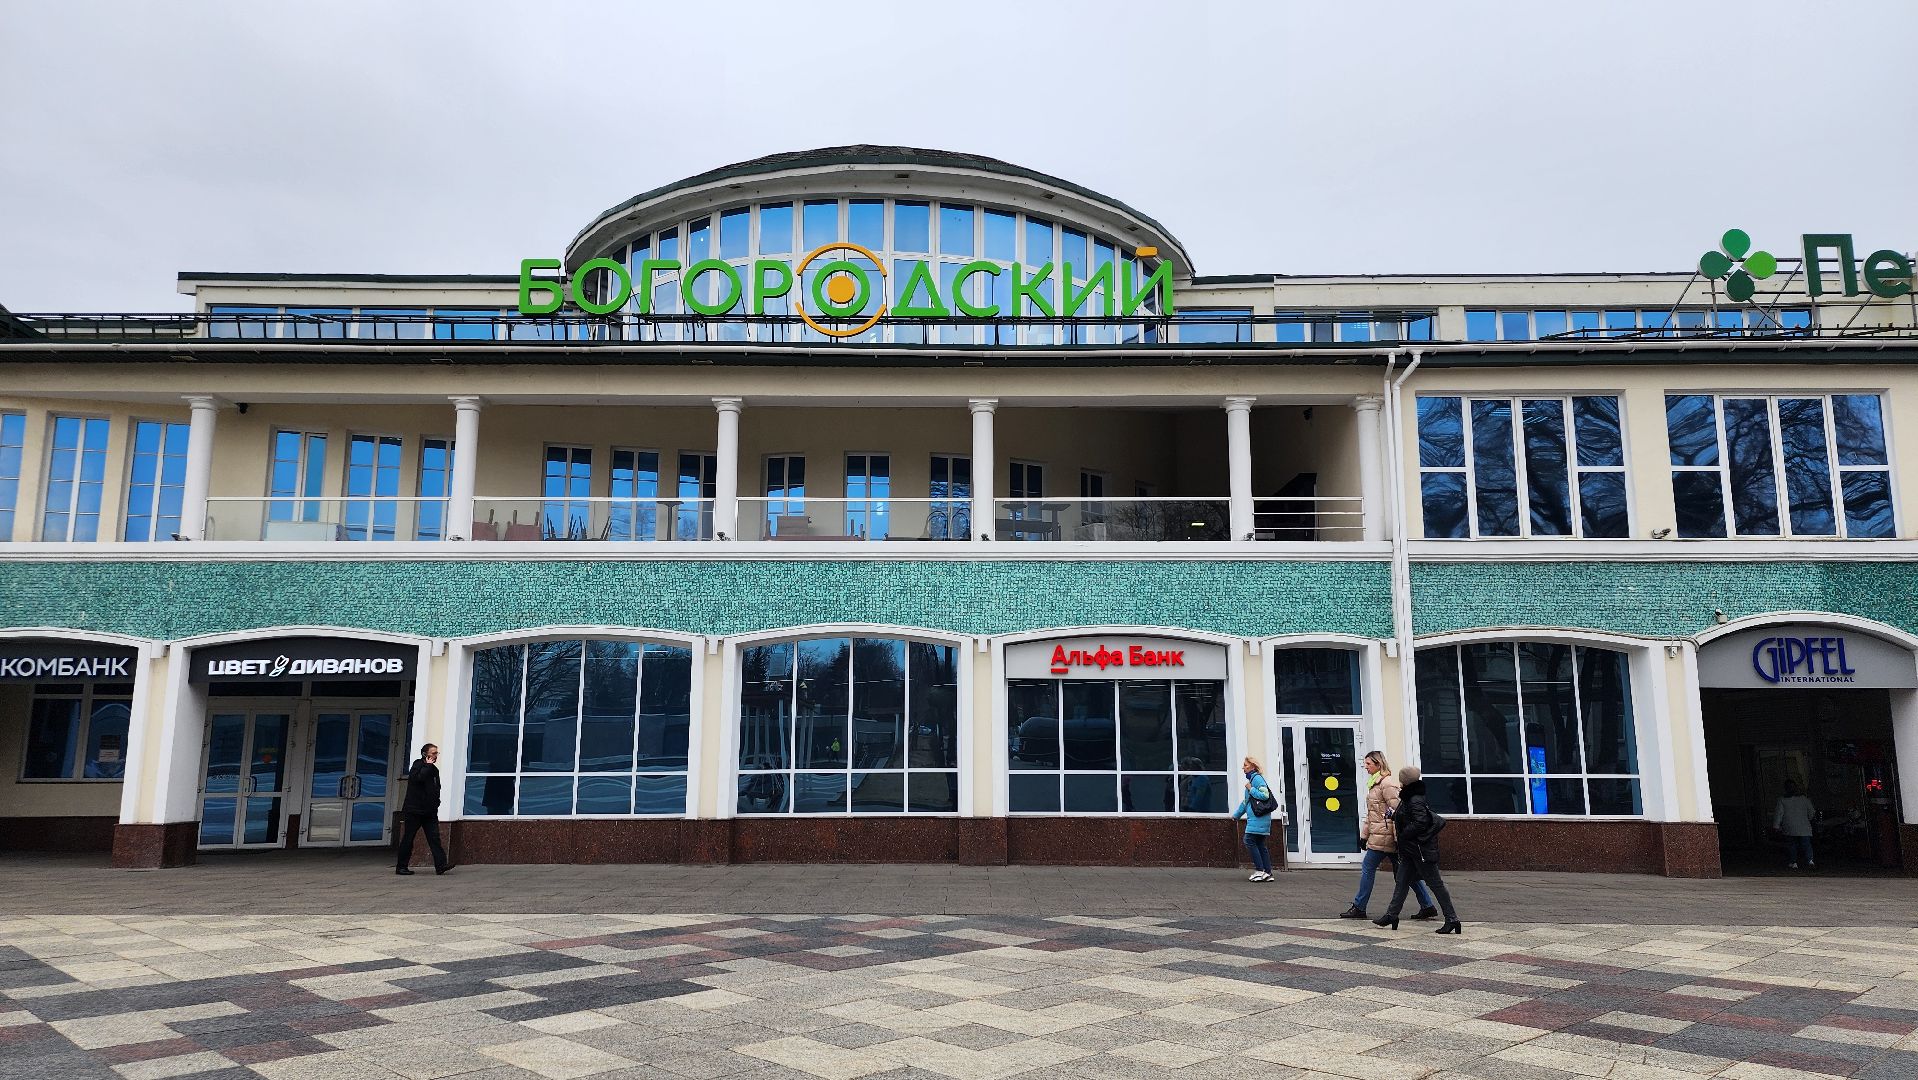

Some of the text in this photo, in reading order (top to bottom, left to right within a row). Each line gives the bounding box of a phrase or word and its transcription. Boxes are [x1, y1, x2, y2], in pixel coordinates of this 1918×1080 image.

[1802, 234, 1918, 298] Пе
[518, 246, 1175, 317] БОГОРОДСКИЙ
[0, 657, 129, 677] КОМБАНК
[208, 658, 404, 676] ЦВЕТ ДИВАНОВ
[1050, 644, 1185, 673] Альфа Банк
